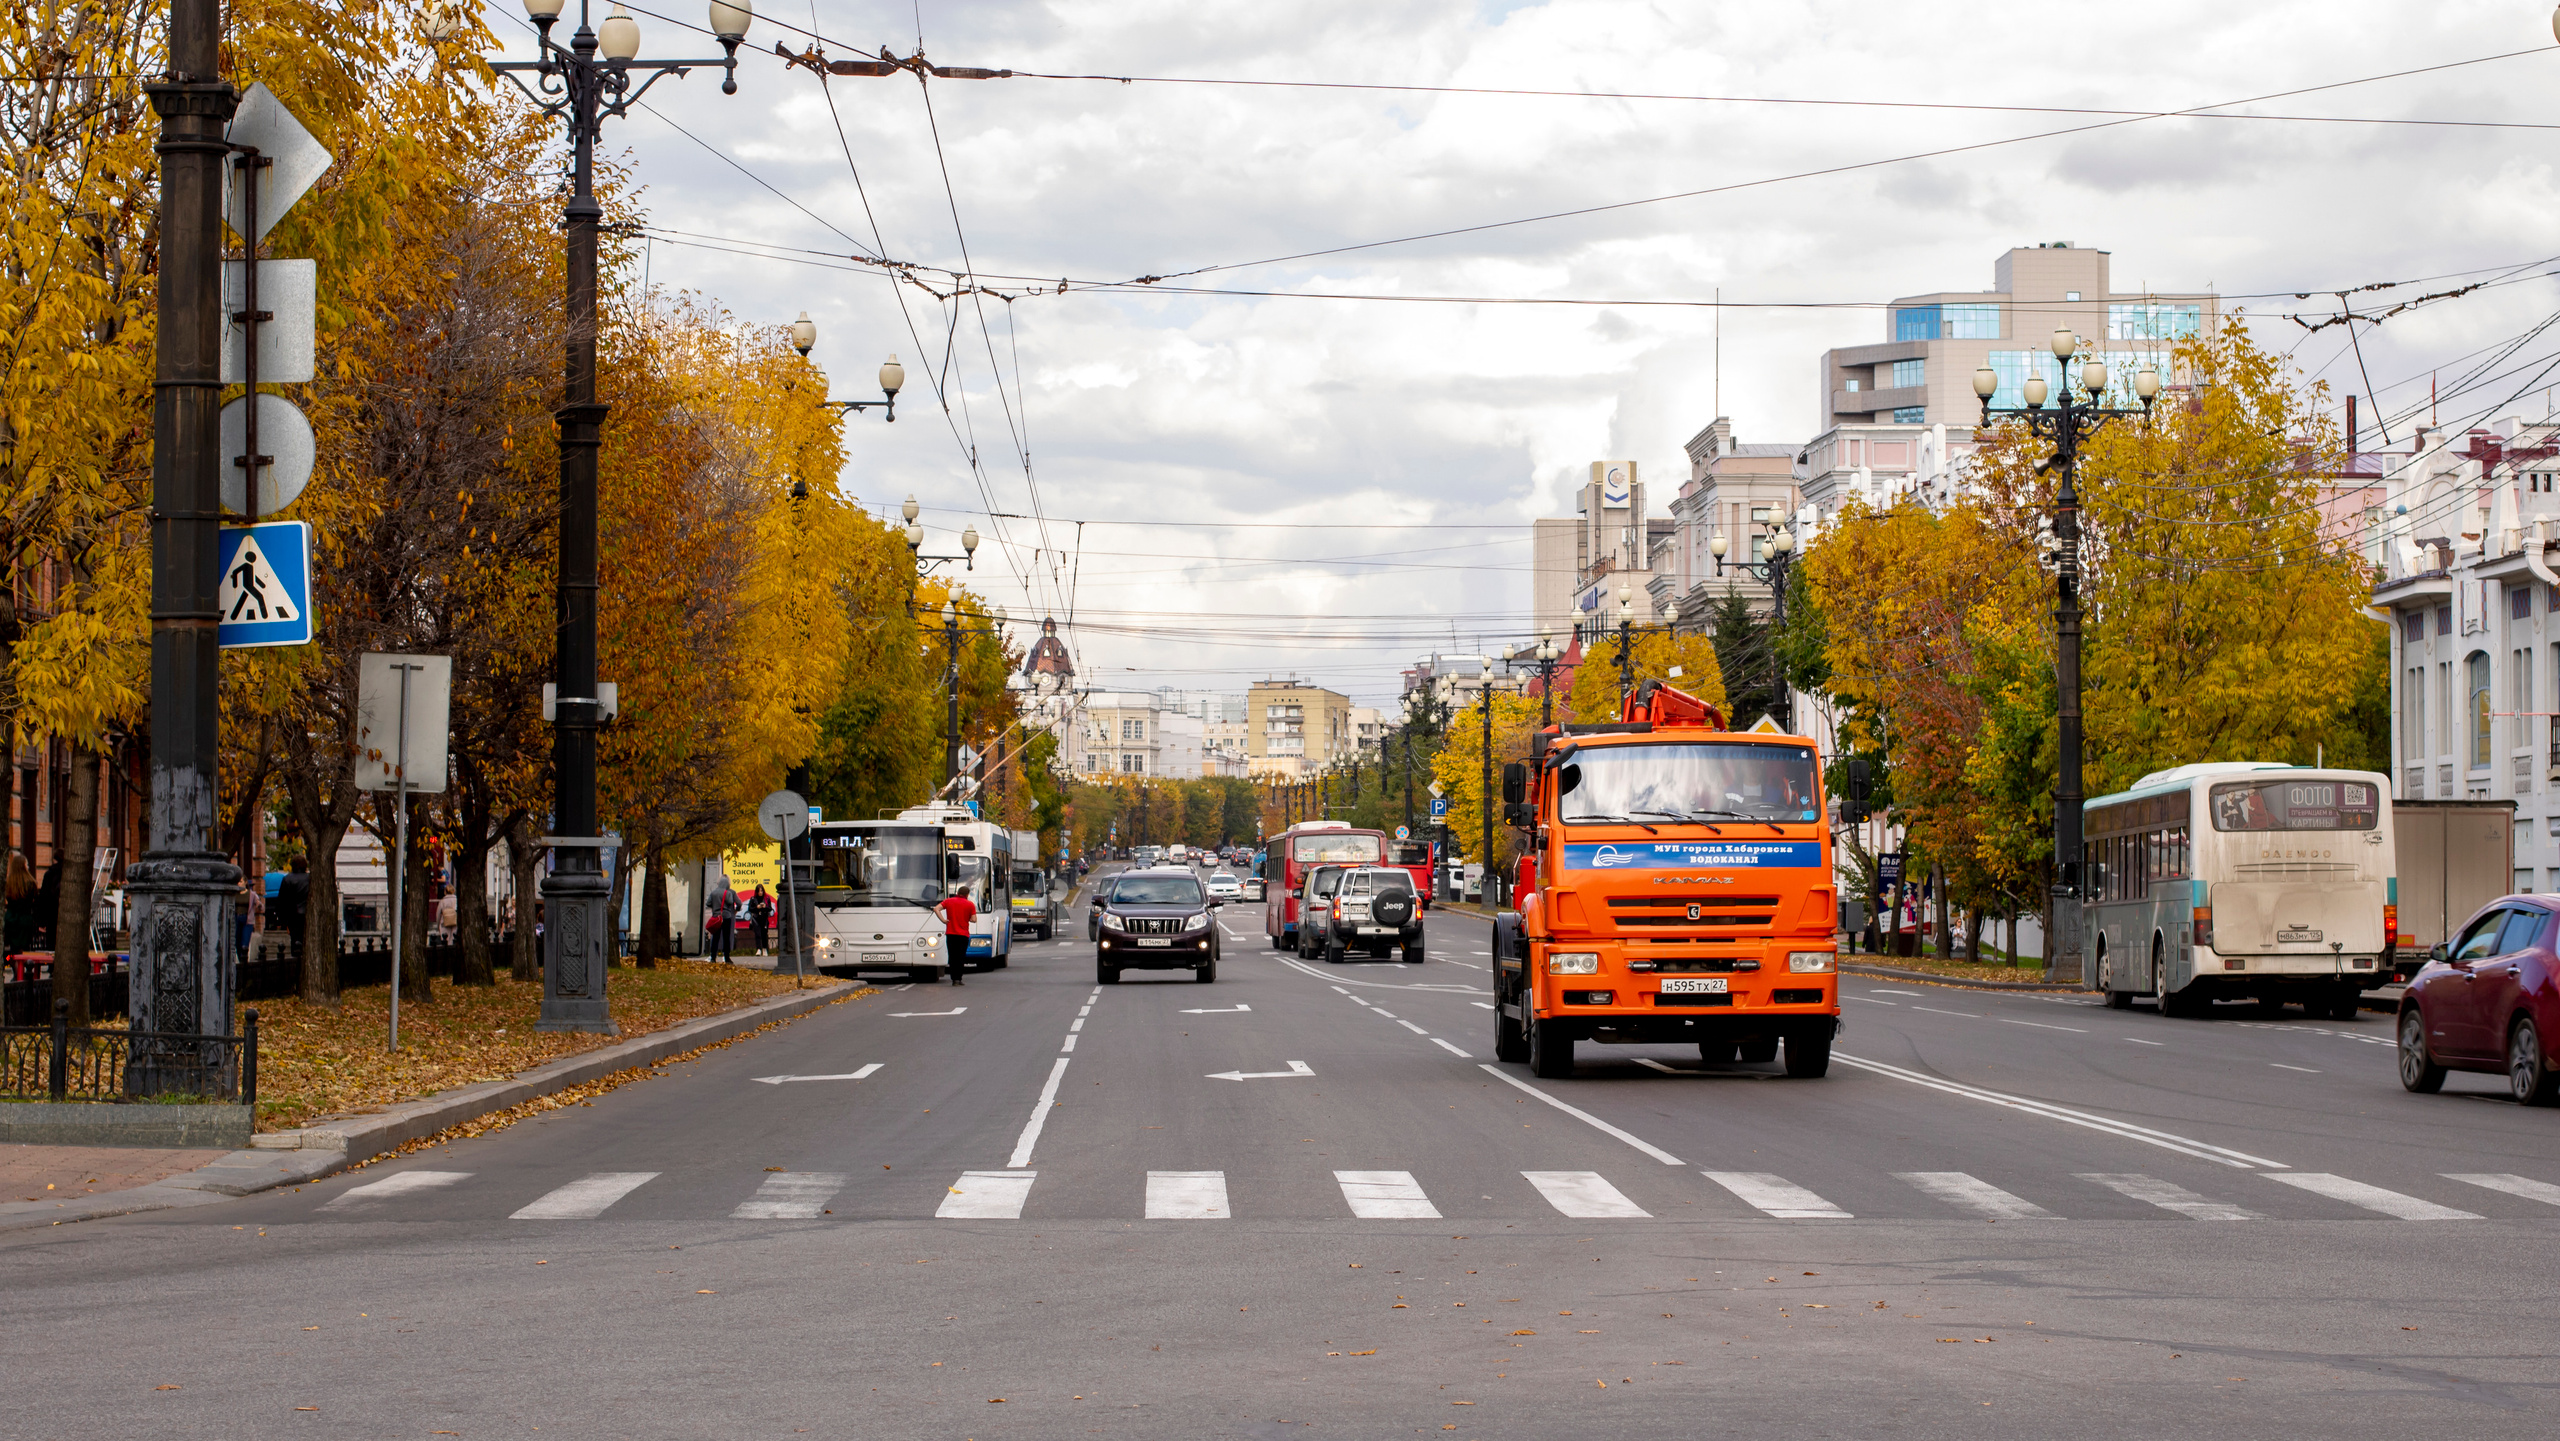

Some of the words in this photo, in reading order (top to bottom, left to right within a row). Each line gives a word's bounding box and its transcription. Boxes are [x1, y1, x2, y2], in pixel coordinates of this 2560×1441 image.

[2291, 786, 2332, 806] ФОТО
[1436, 802, 1444, 813] P
[2291, 819, 2333, 828] КАРТИНЫ
[1683, 845, 1722, 854] города
[1725, 845, 1793, 854] Хабаровска
[2261, 850, 2332, 858] DAEWOO
[732, 860, 764, 868] Закажи
[1690, 856, 1759, 864] ВОДОКАНАЛ
[1383, 902, 1405, 911] Jeep
[1666, 980, 1710, 992] Н595ТХ
[1712, 980, 1724, 989] 27
